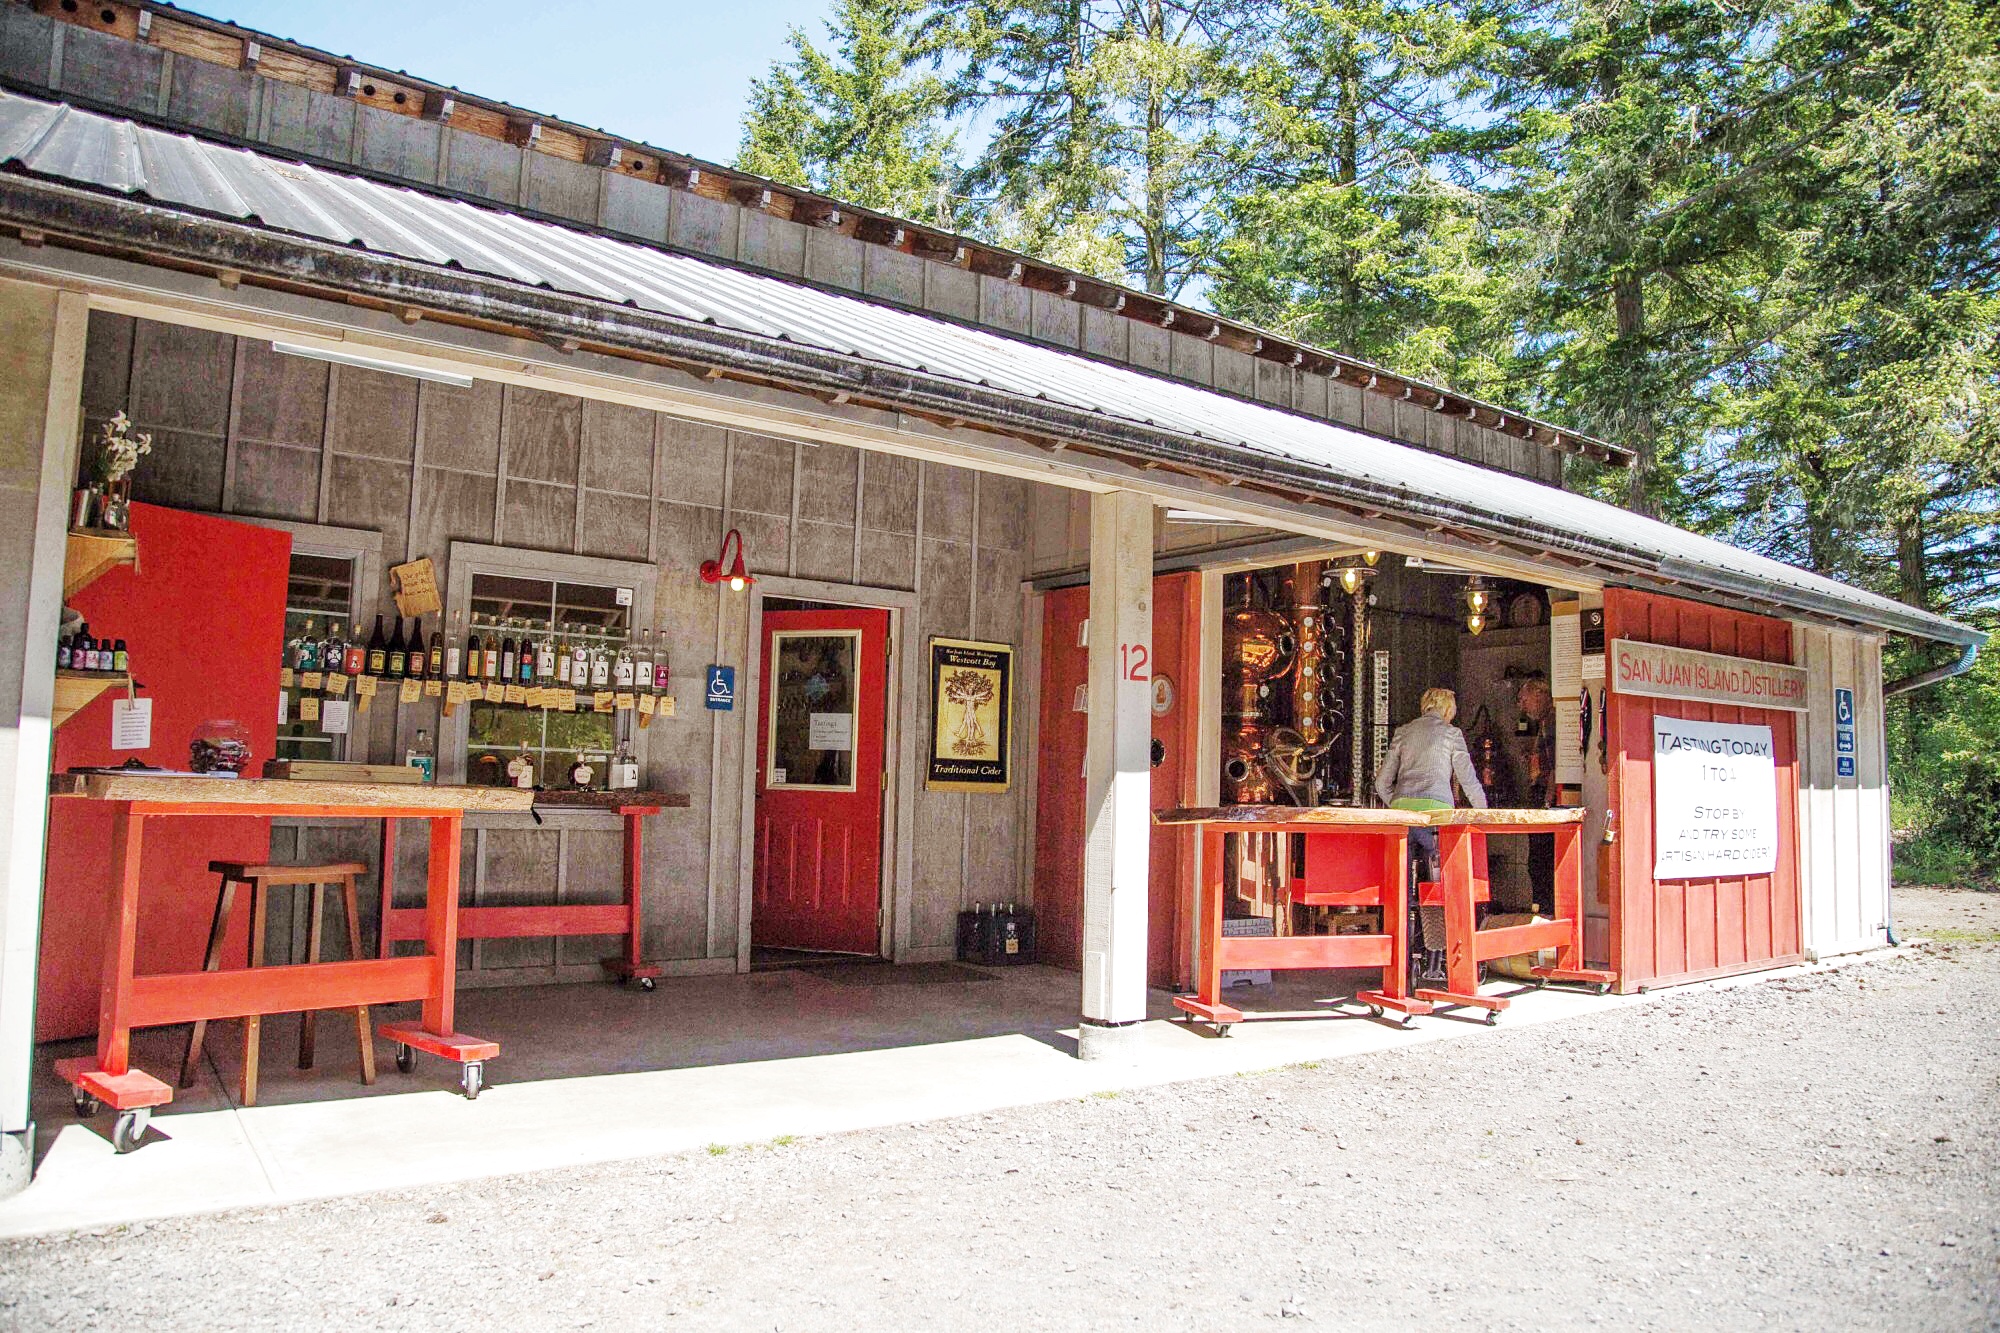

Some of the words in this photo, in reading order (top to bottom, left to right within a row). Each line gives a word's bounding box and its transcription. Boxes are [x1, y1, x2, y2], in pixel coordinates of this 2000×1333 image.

[949, 655, 981, 665] Westcott
[983, 659, 997, 668] Bay
[1121, 643, 1148, 681] 12
[1619, 652, 1652, 682] SAN
[1656, 658, 1691, 688] JUAN
[1695, 662, 1740, 693] ISLAND
[1742, 670, 1804, 699] DISTILLERY
[1658, 732, 1721, 754] TASTING
[1721, 739, 1768, 756] TODAY
[934, 764, 979, 775] Traditional
[981, 766, 1003, 776] Cider
[1710, 766, 1728, 782] TO
[1693, 805, 1730, 820] STOP
[1732, 808, 1746, 820] BY
[1702, 828, 1729, 840] TRY
[1731, 828, 1757, 840] SOME
[1707, 849, 1741, 860] HARD
